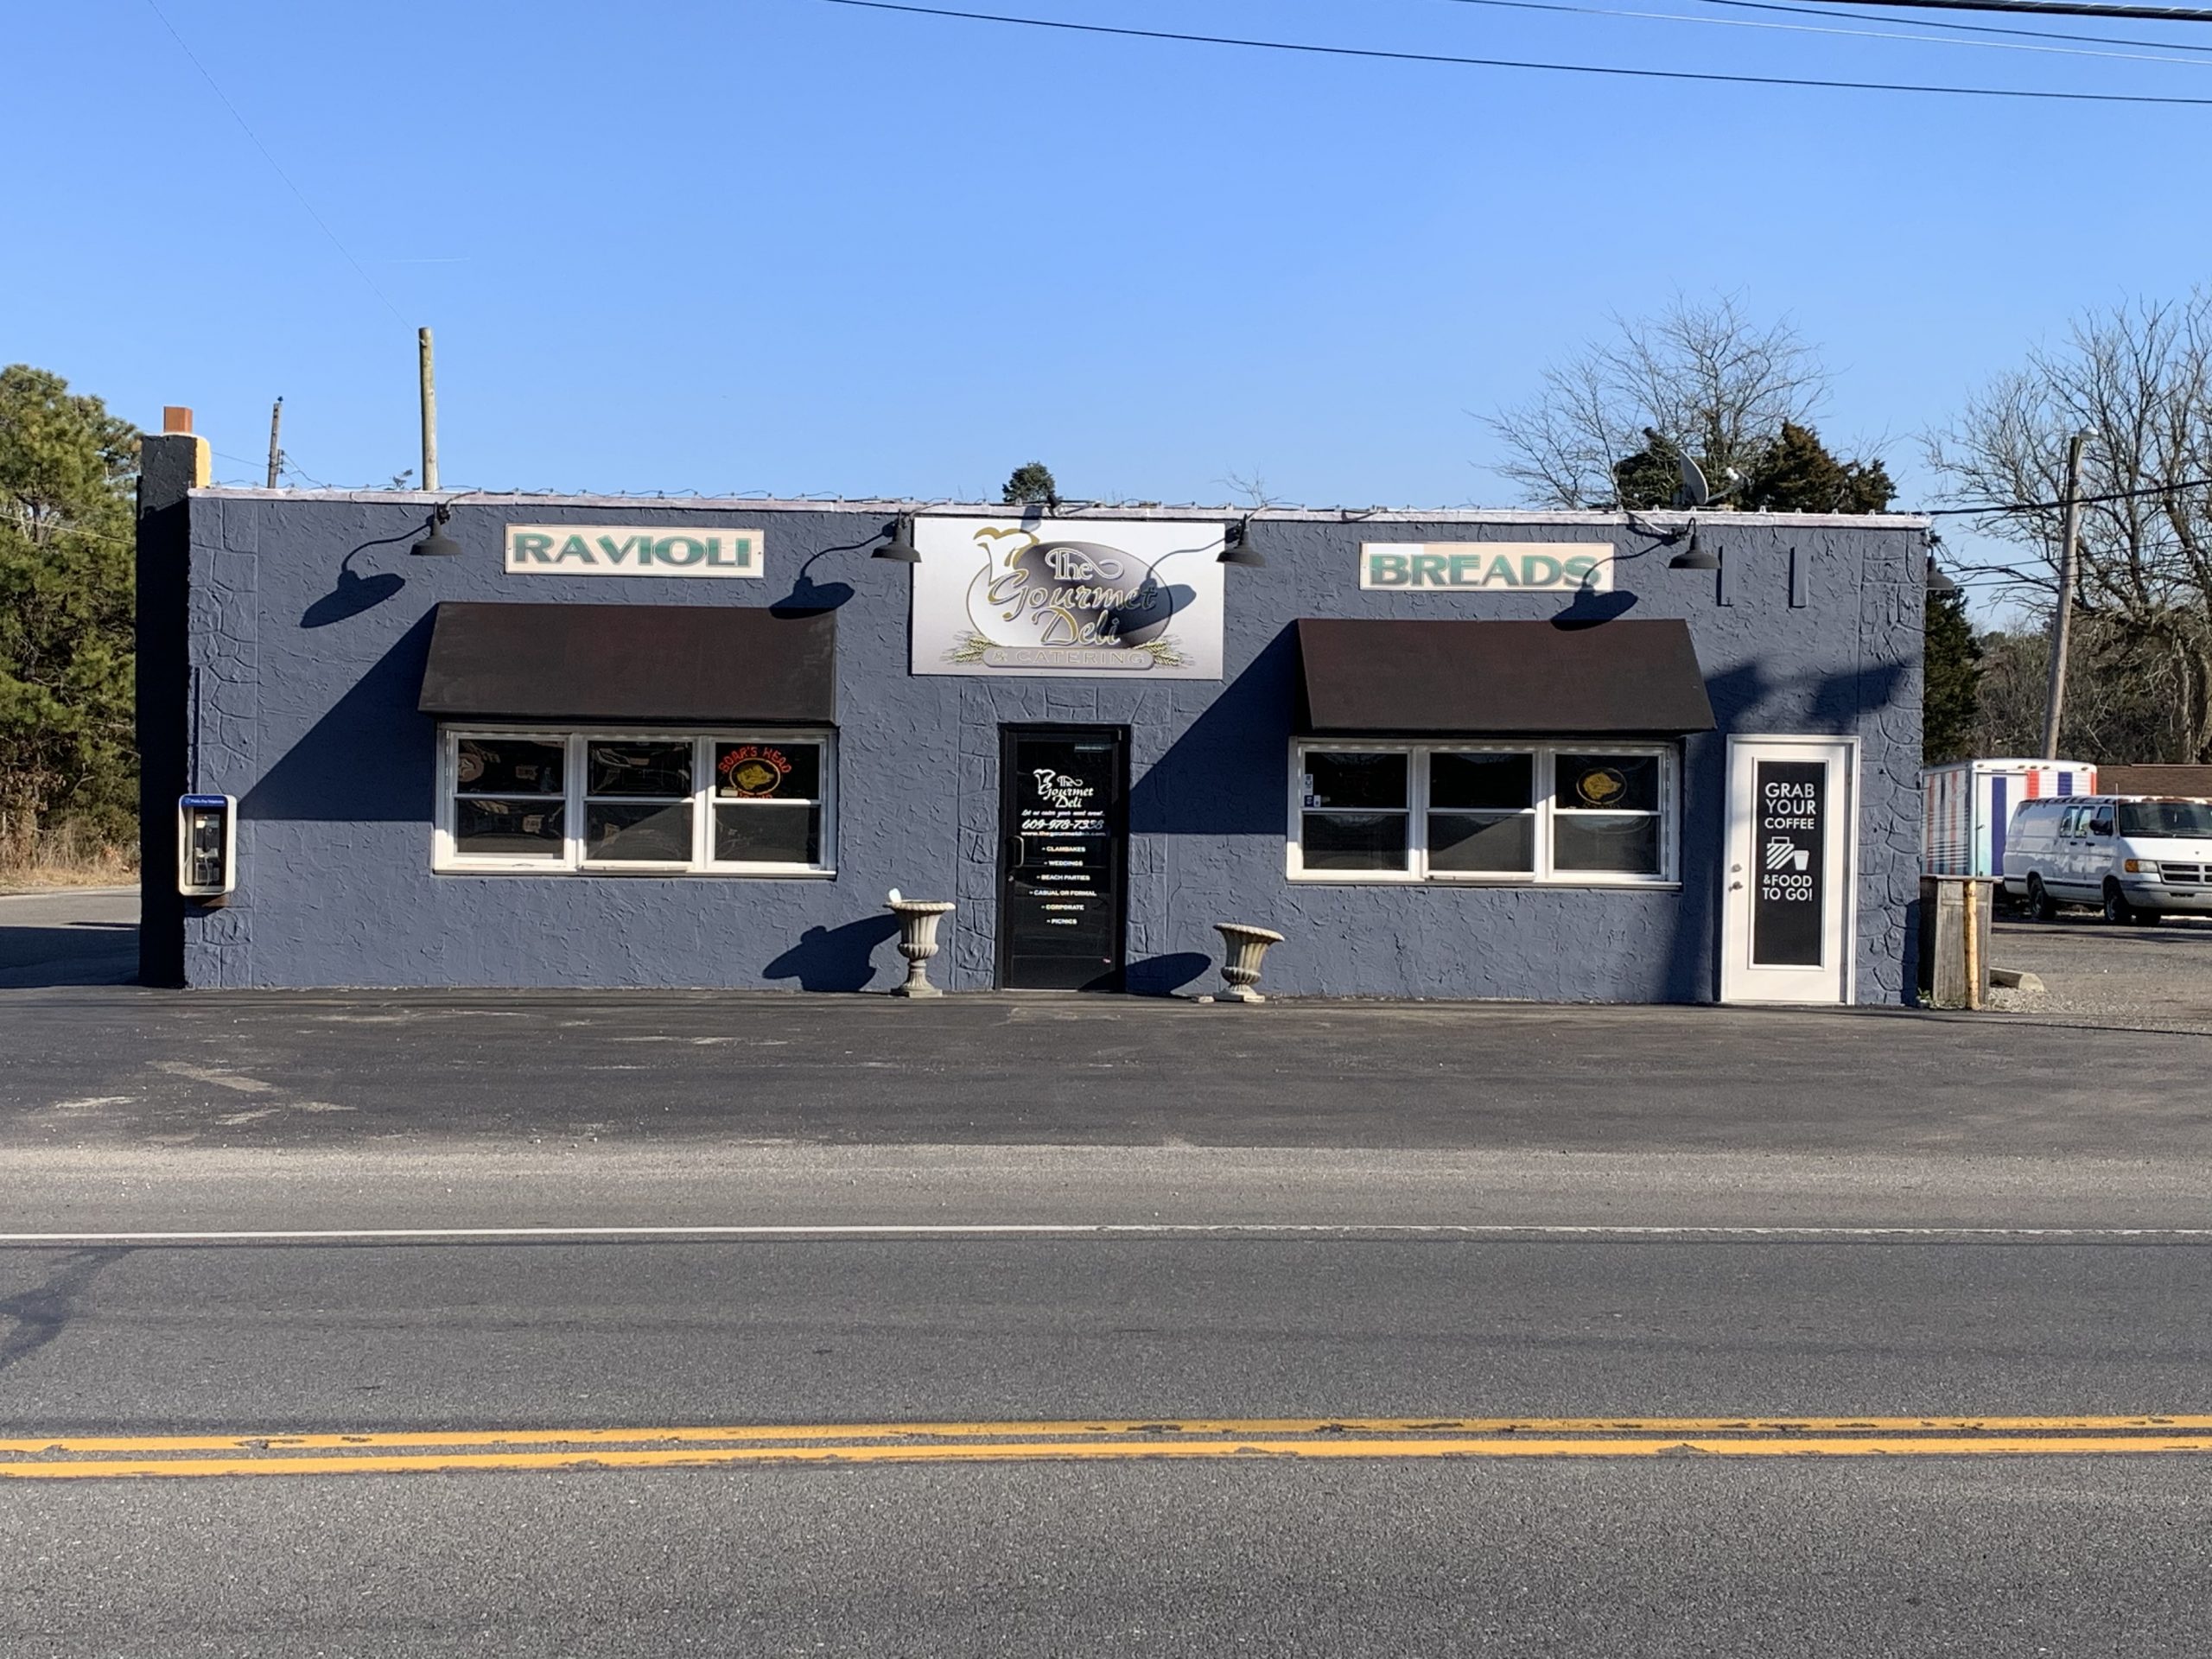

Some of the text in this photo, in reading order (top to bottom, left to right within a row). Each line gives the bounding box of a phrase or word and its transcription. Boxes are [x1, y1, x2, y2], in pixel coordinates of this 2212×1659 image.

[512, 532, 752, 568] RAVIOLI
[1046, 547, 1124, 581] The
[1369, 554, 1602, 588] BREADS
[988, 568, 1159, 621] Gourmet
[1032, 607, 1122, 646] Deli
[993, 650, 1146, 665] & CATERING
[718, 746, 792, 773] BOAR'S HEAD
[1056, 775, 1084, 787] The
[1764, 782, 1815, 798] GRAB
[1038, 782, 1094, 801] Gourmet
[1052, 795, 1083, 808] Deli
[1765, 798, 1816, 815] YOUR
[1764, 817, 1815, 830] COFFEE
[1762, 887, 1813, 901] TO GO!
